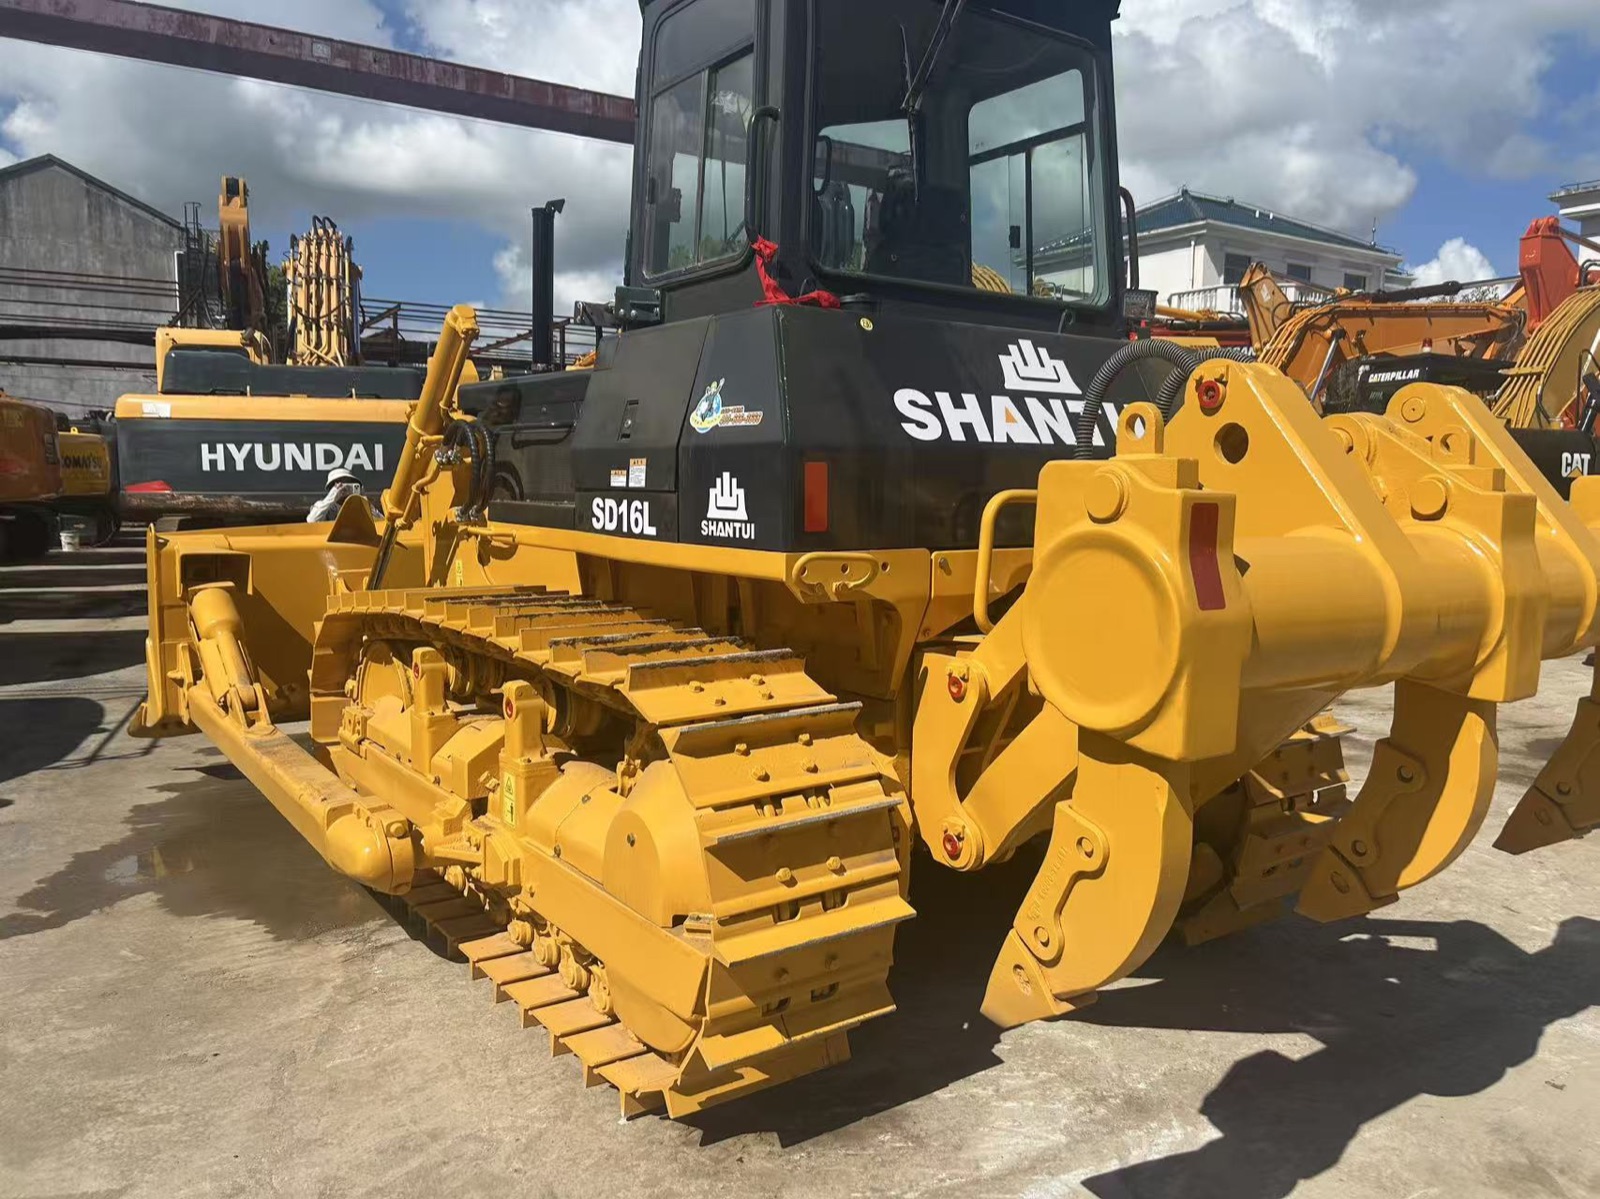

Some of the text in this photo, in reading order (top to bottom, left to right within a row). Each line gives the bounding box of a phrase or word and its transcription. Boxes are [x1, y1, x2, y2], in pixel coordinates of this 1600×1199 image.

[1368, 368, 1420, 383] CATERPILLAR
[201, 443, 384, 471] HYUNDAI
[1561, 452, 1591, 478] CAT
[591, 497, 657, 536] SD16L
[700, 519, 755, 540] SHANTUI
